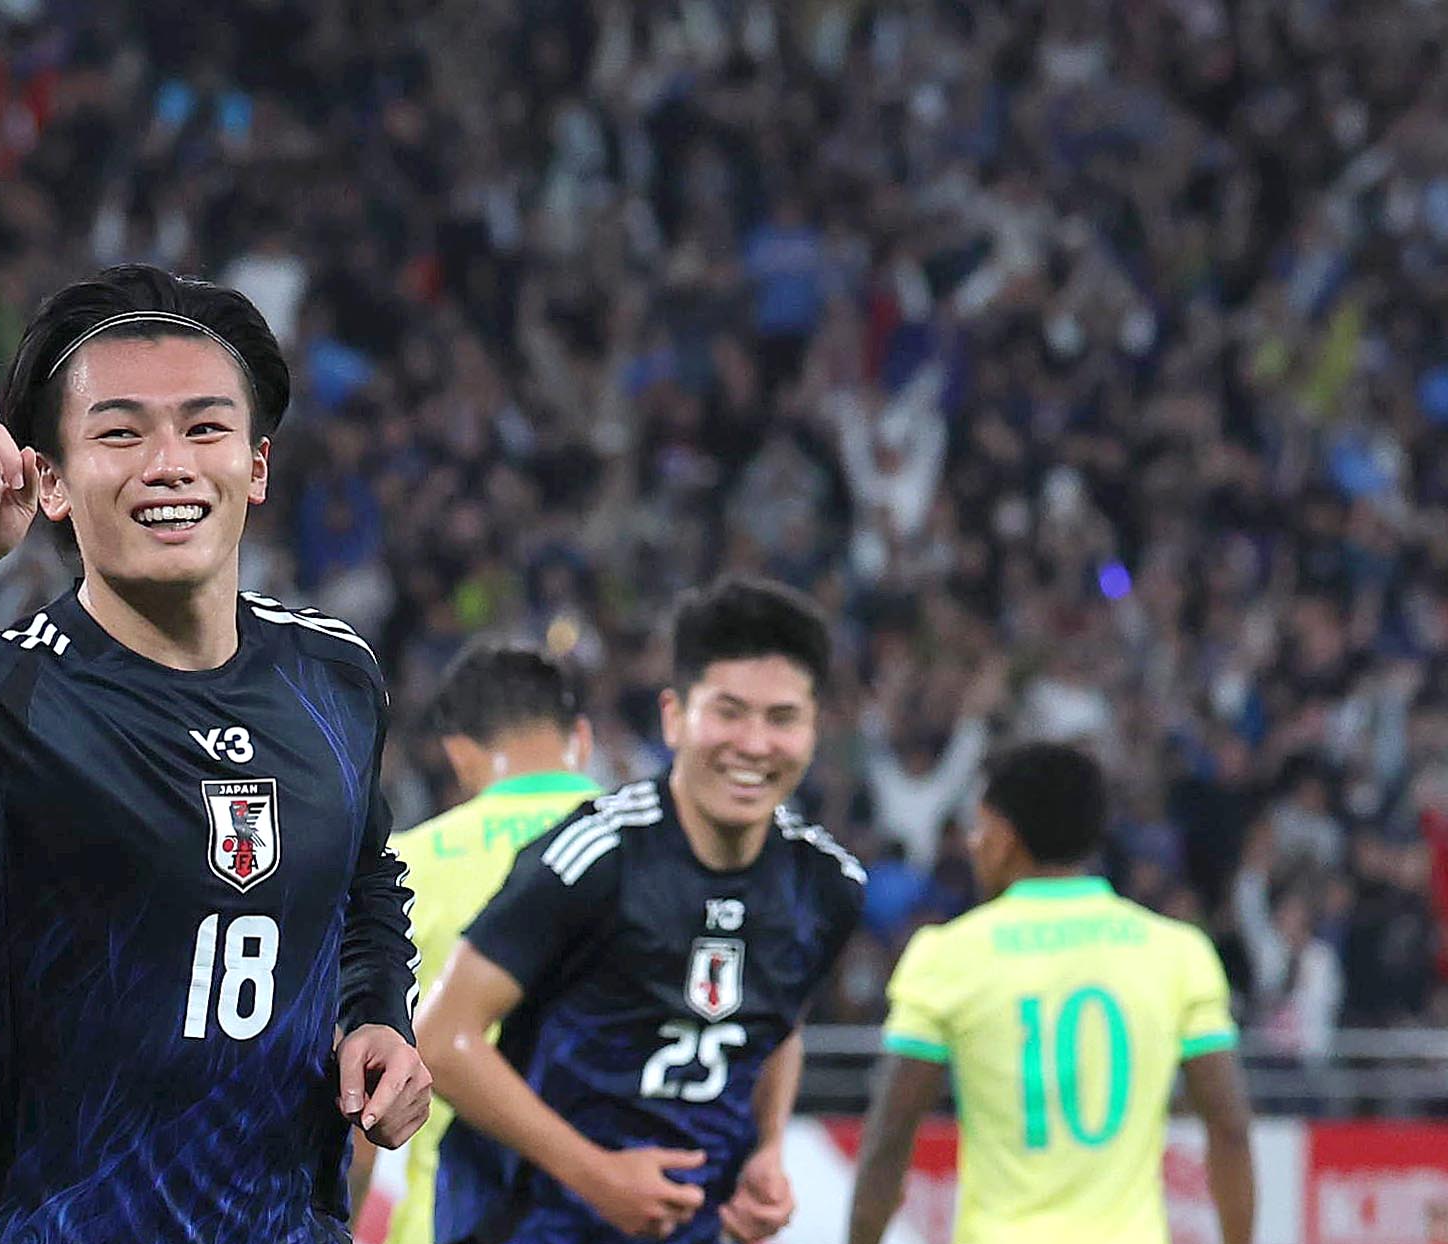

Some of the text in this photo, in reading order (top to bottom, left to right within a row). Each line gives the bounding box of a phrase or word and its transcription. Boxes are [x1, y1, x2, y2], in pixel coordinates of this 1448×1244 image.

[189, 727, 254, 763] Y-3
[219, 784, 258, 795] JAPAN
[228, 854, 259, 870] JFA
[183, 914, 280, 1040] 18
[641, 1021, 747, 1102] 25
[1019, 984, 1131, 1150] 10
